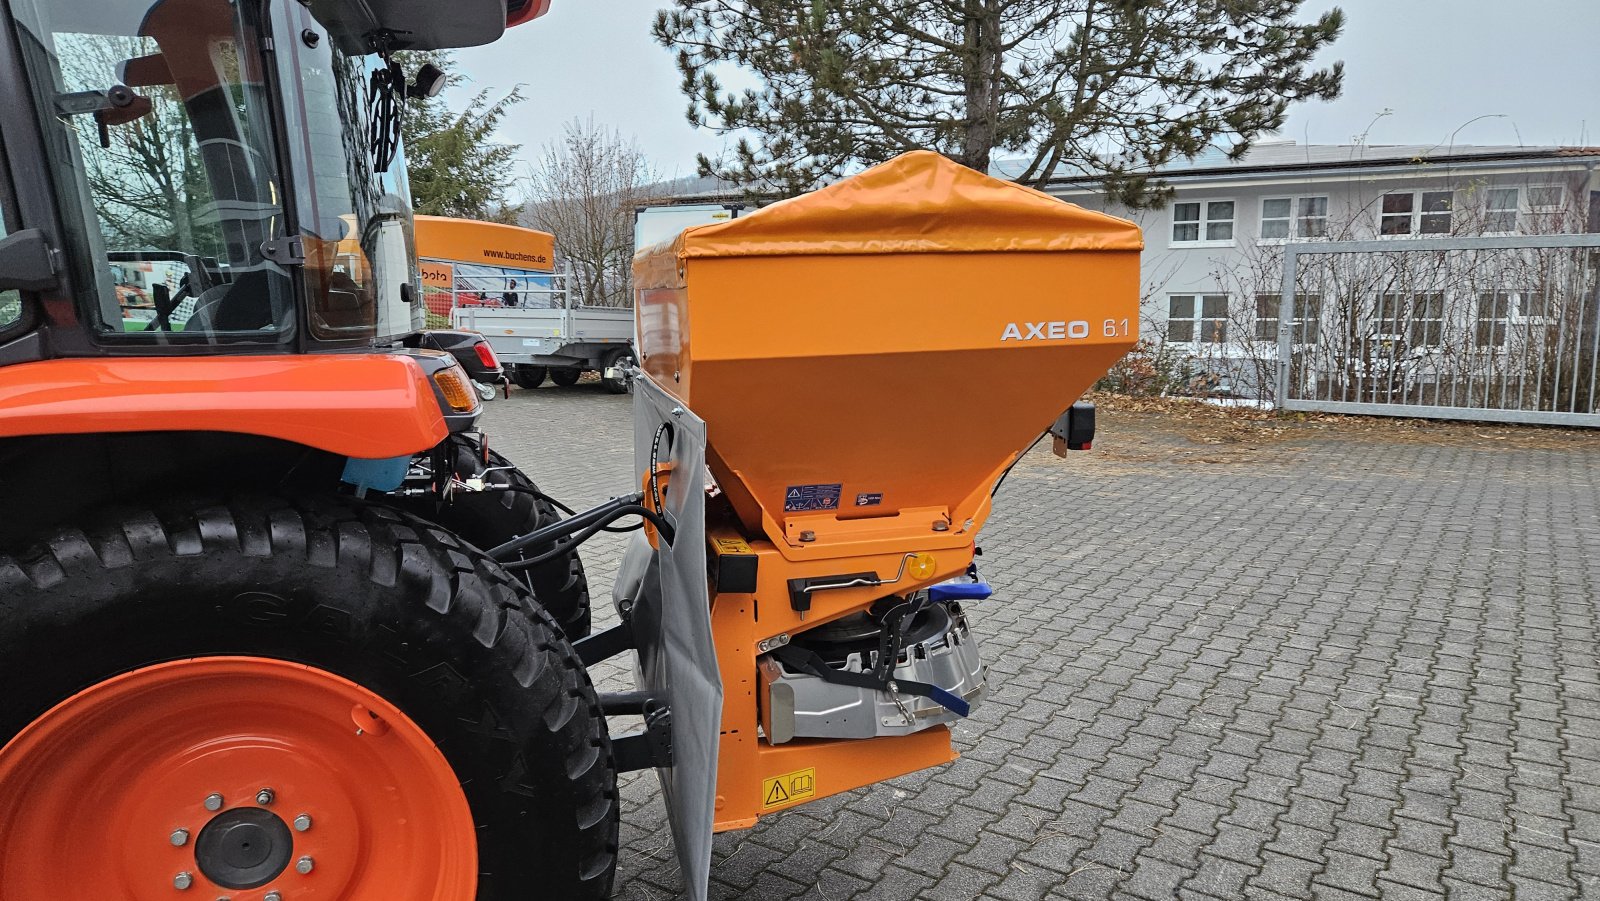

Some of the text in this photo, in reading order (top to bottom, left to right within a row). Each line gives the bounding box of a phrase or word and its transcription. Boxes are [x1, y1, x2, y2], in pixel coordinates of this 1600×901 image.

[483, 249, 547, 264] www.buchens.de
[421, 268, 447, 281] bota
[1000, 318, 1129, 341] AXEO 6.1
